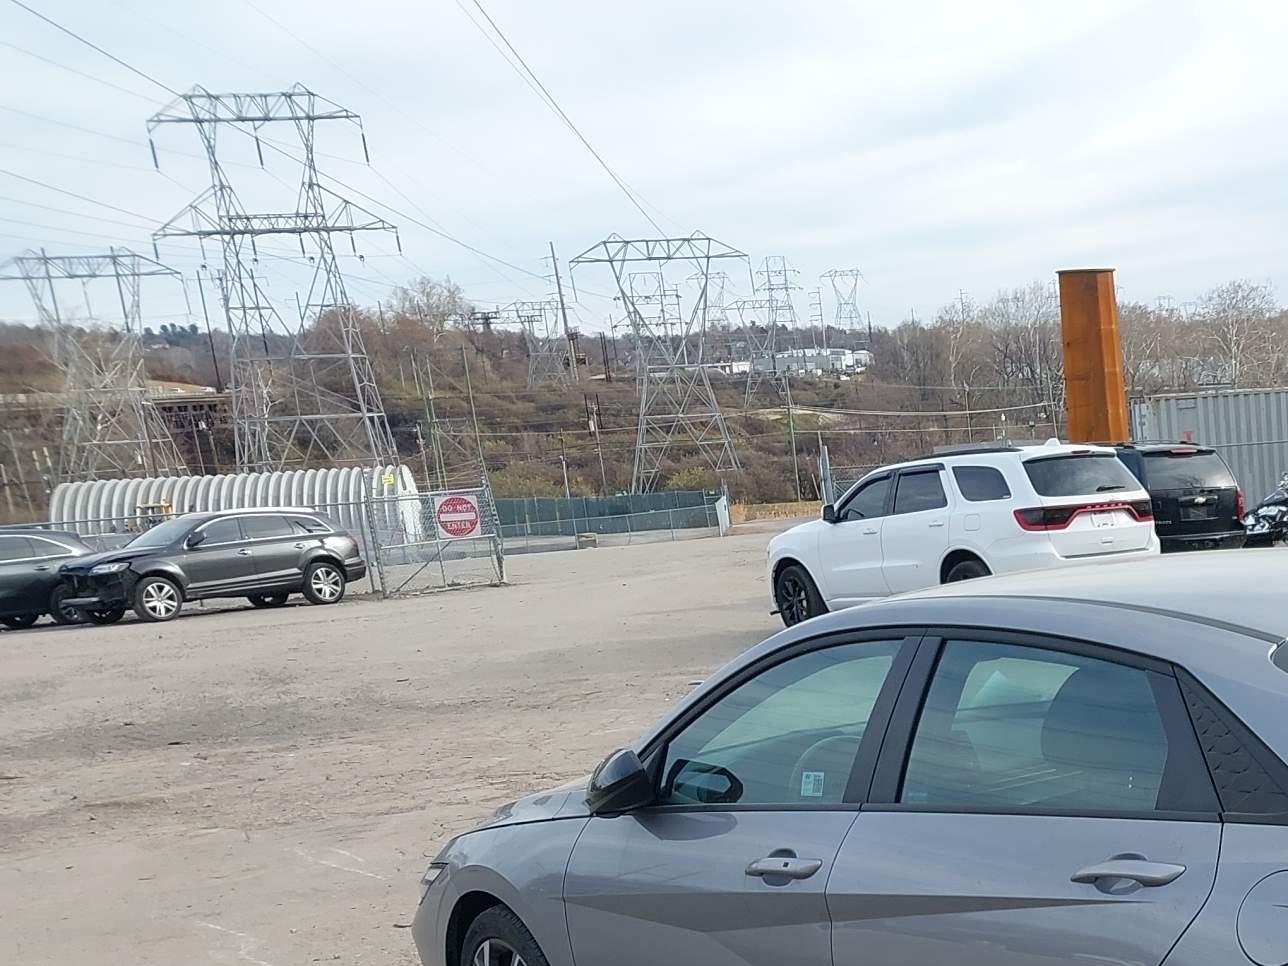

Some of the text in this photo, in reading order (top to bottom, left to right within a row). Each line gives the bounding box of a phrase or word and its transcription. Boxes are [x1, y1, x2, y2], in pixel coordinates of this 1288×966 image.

[441, 503, 471, 512] DO NOT
[447, 520, 472, 530] ENTER
